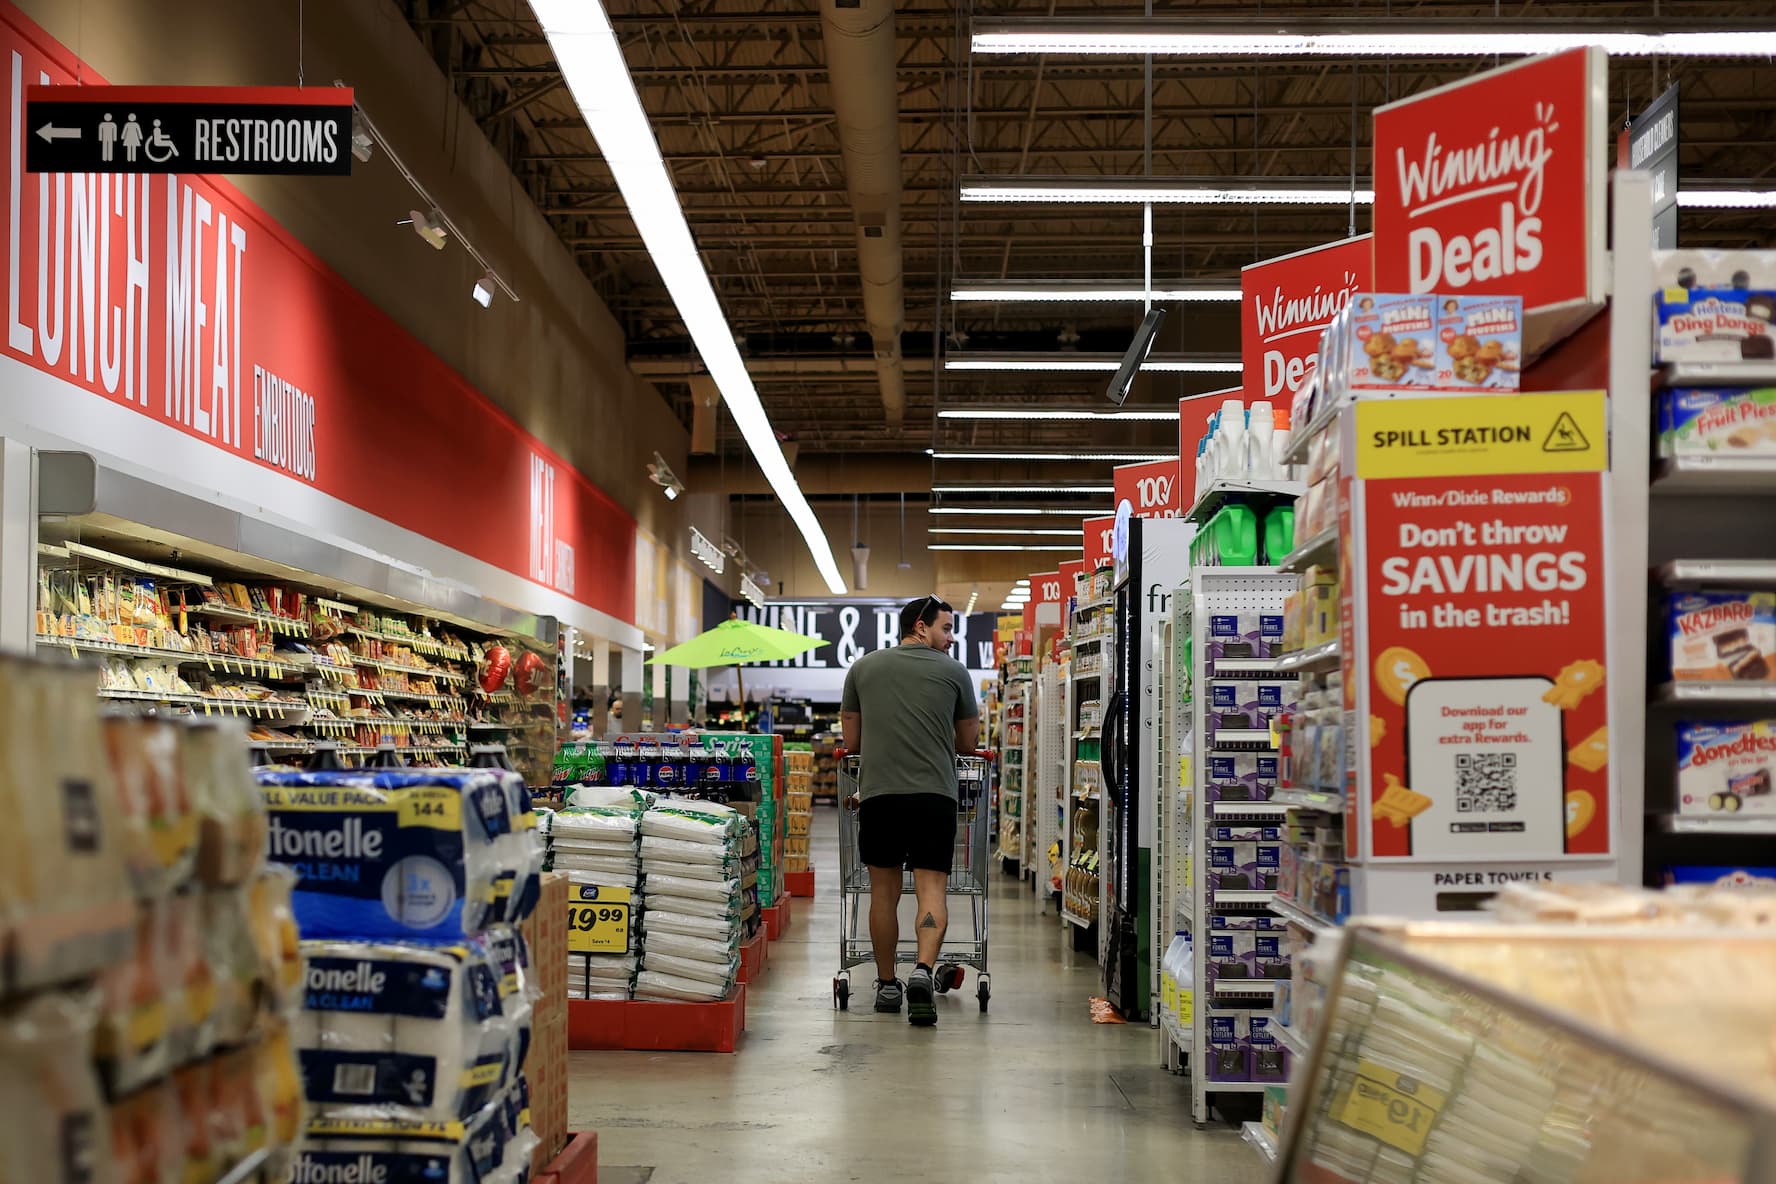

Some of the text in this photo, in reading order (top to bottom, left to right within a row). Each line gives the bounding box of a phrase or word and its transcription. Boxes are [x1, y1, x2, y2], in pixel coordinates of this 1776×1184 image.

[194, 118, 338, 163] RESTROOMS
[1396, 126, 1554, 215] Winning
[9, 49, 247, 450] LUNCH MEAT
[1409, 201, 1542, 294] Deals
[1673, 317, 1713, 334] Ding
[252, 363, 317, 482] EMBUTIDOS
[1696, 408, 1737, 435] Fruit
[1373, 425, 1532, 448] SPILL STATION
[1491, 486, 1566, 505] Rewards
[1399, 519, 1568, 547] Don't throw
[1380, 551, 1588, 596] SAVINGS
[1146, 583, 1172, 613] fr
[1399, 599, 1571, 629] in the trash!
[837, 606, 865, 669] &
[876, 611, 968, 668] BR
[1440, 705, 1529, 718] Download our
[1462, 719, 1508, 732] app for
[1437, 733, 1472, 745] extra
[1691, 732, 1776, 767] donettes
[288, 791, 339, 805] VALUE
[412, 802, 446, 817] 144
[267, 816, 383, 858] tonelle
[293, 863, 360, 882] CLEAN
[1434, 872, 1484, 886] PAPER
[304, 962, 387, 994] onelle
